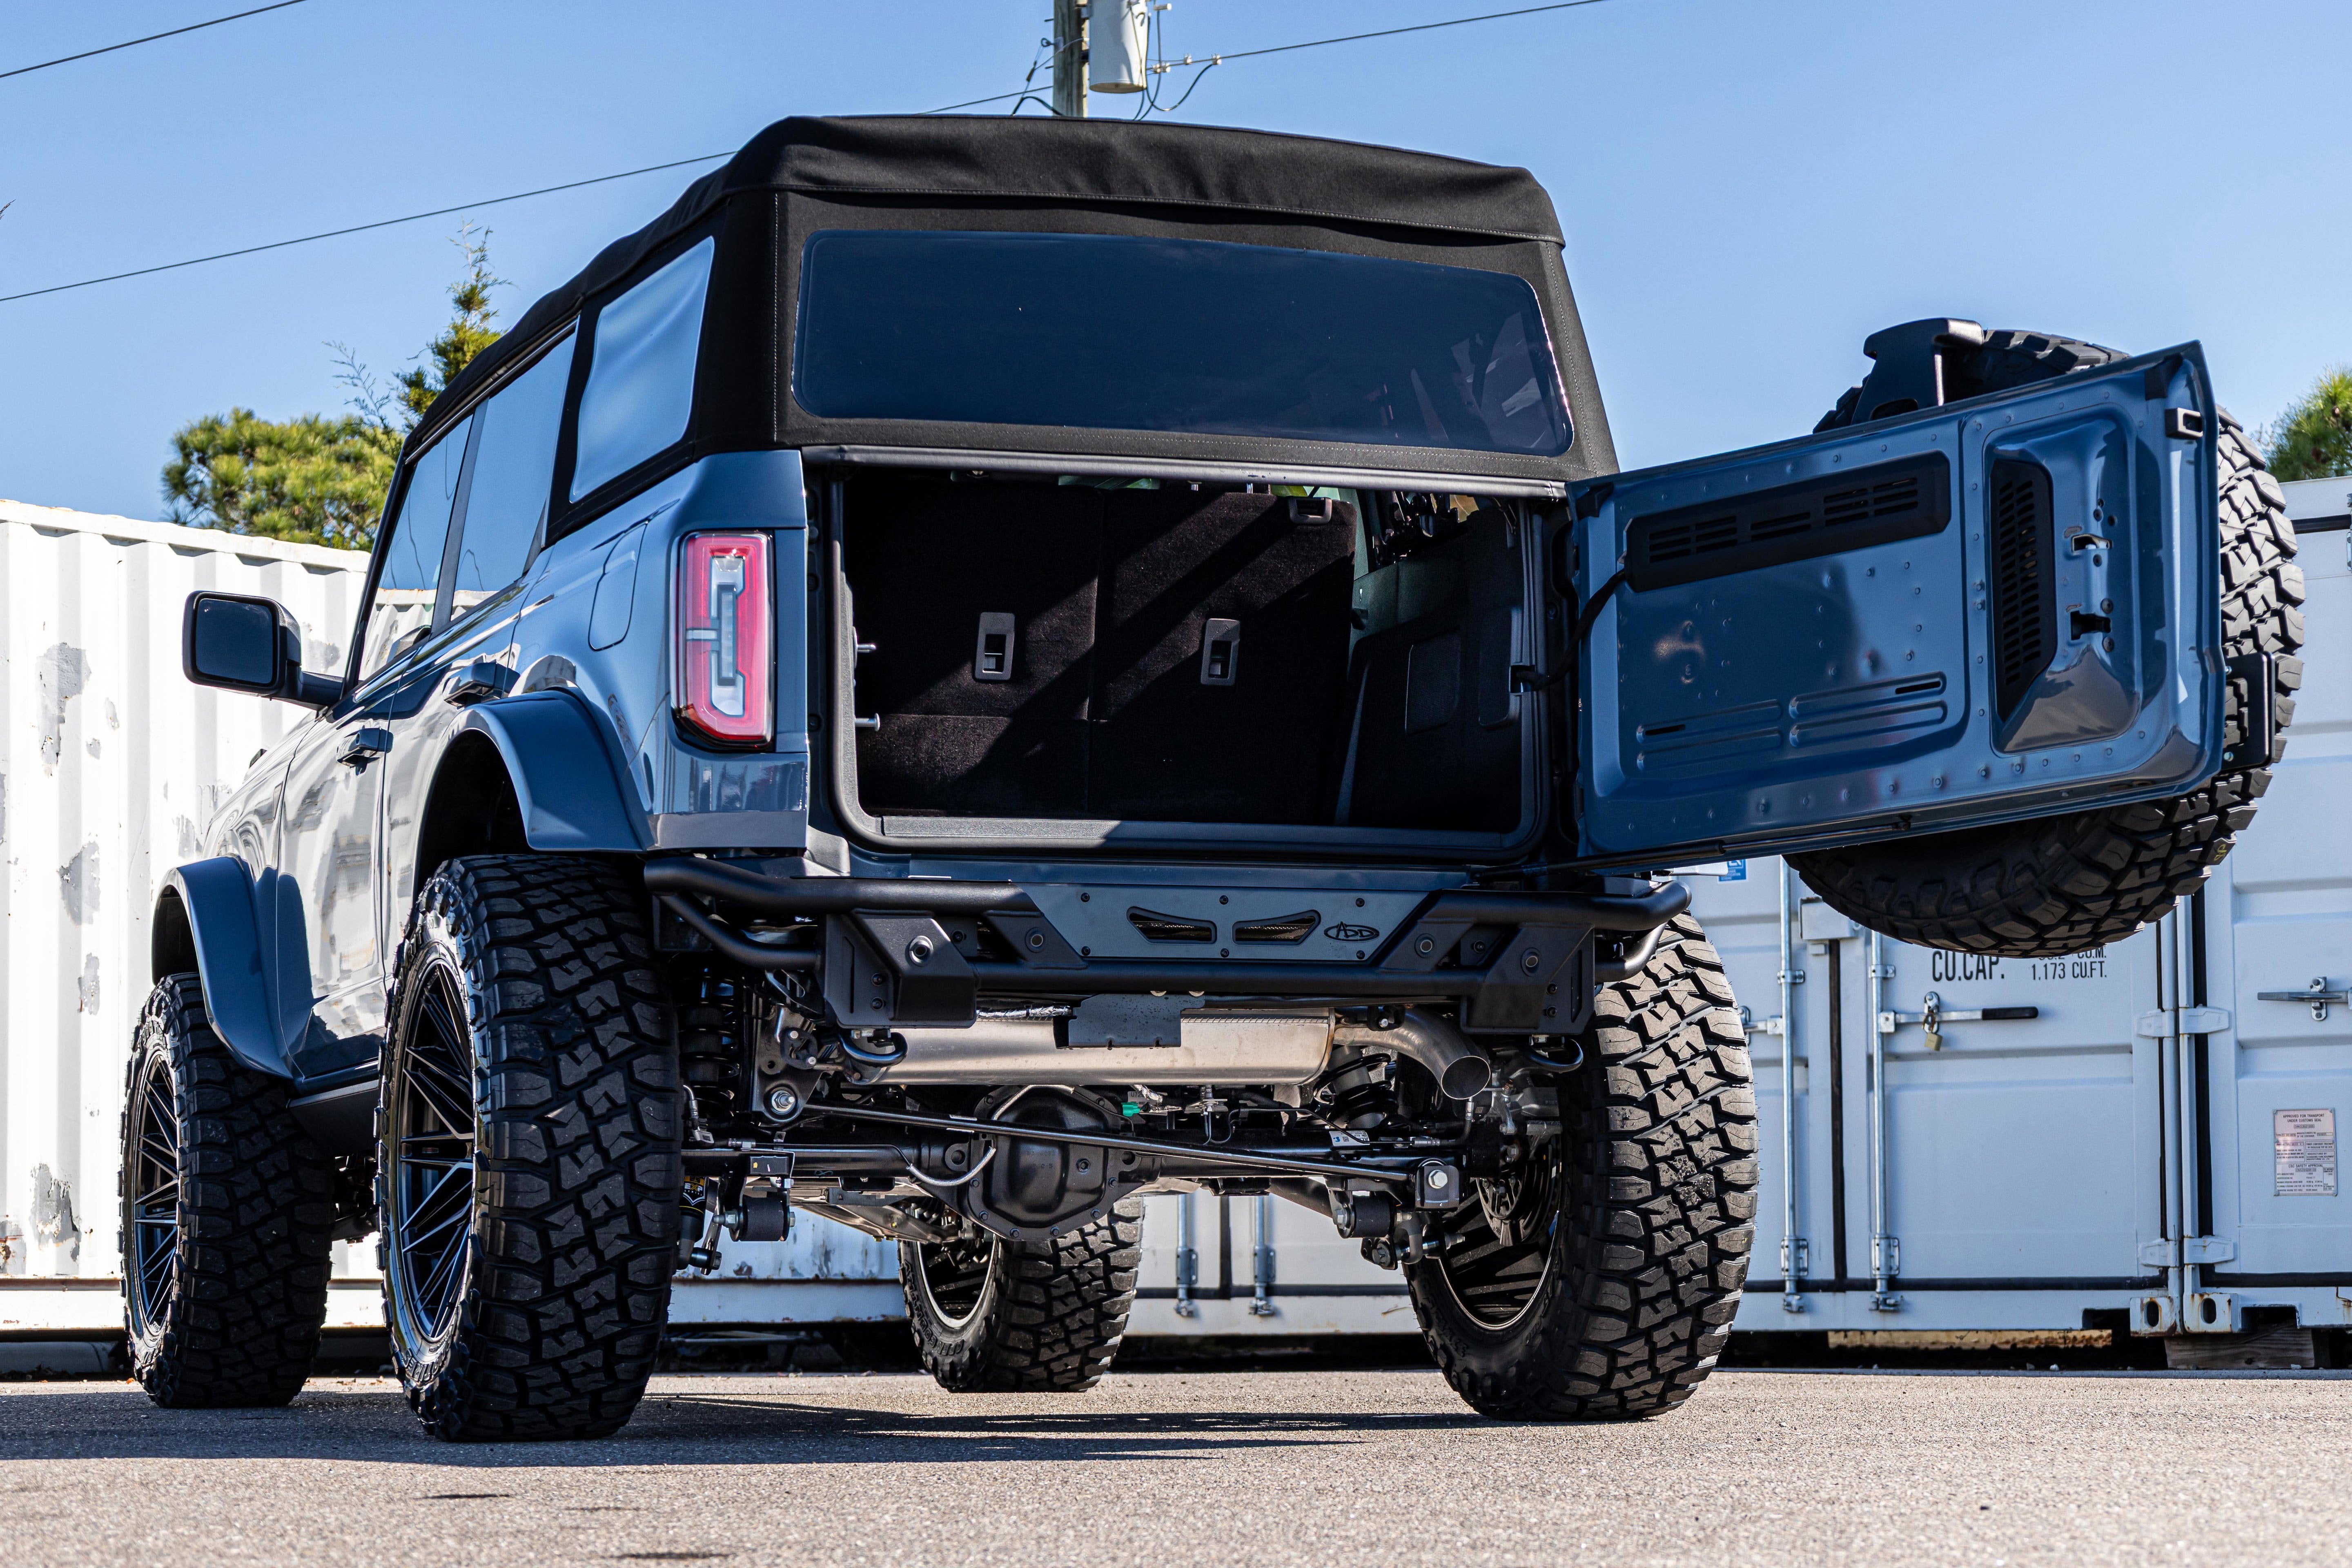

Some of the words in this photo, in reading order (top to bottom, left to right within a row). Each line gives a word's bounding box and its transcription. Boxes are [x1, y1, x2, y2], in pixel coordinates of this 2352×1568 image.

[1932, 950, 2005, 982] CU.CAP.
[2072, 961, 2107, 978] CU.FT.
[402, 1348, 431, 1383] TIRES
